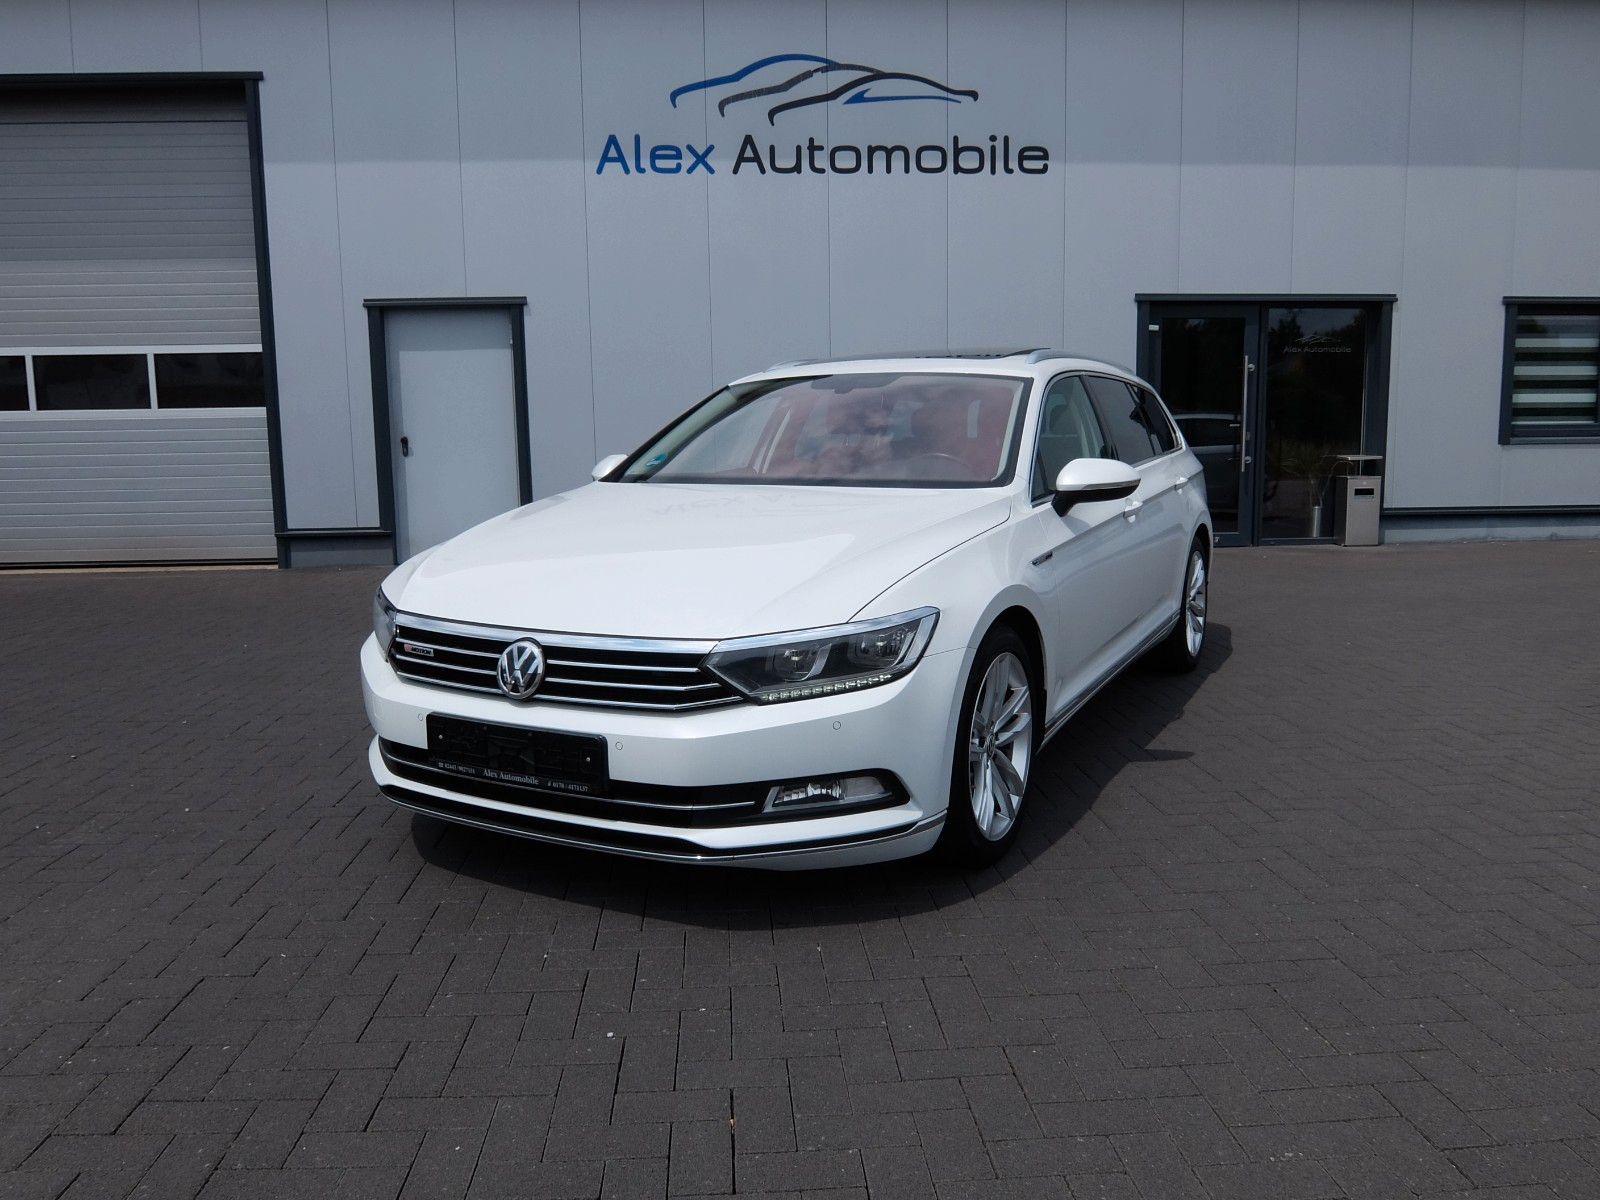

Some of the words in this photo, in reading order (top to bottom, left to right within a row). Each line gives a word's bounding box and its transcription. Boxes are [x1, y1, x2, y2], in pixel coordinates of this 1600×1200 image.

[596, 134, 715, 175] Alex
[732, 134, 1049, 175] Automobile
[483, 768, 498, 779] Alex
[499, 771, 539, 786] Automobile
